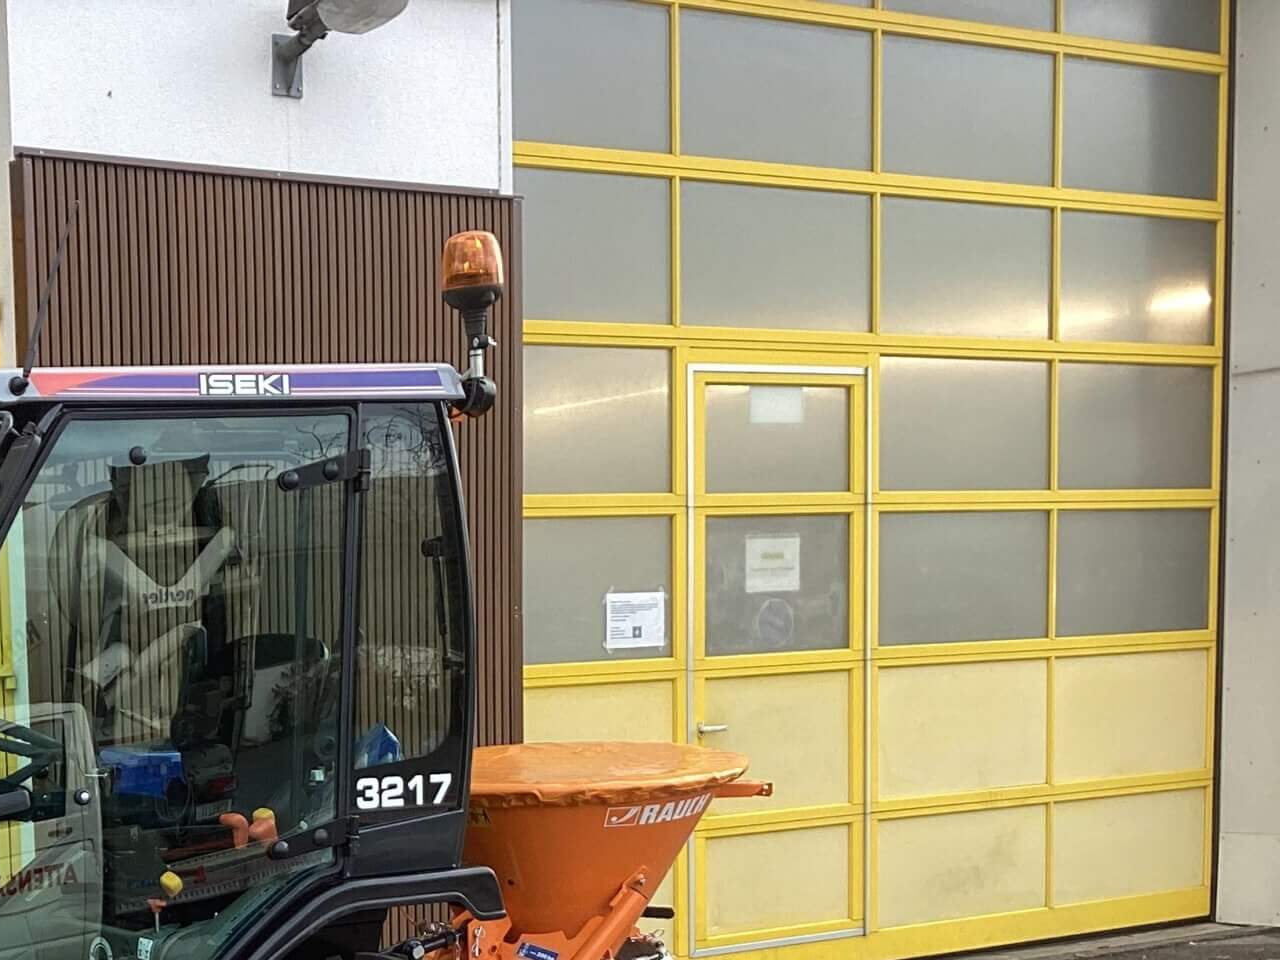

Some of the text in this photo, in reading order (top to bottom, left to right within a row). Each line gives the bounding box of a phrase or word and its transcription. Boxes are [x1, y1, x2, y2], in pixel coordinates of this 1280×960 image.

[199, 373, 290, 395] ISEKI
[356, 772, 452, 810] 3217
[638, 792, 711, 825] RAUCH
